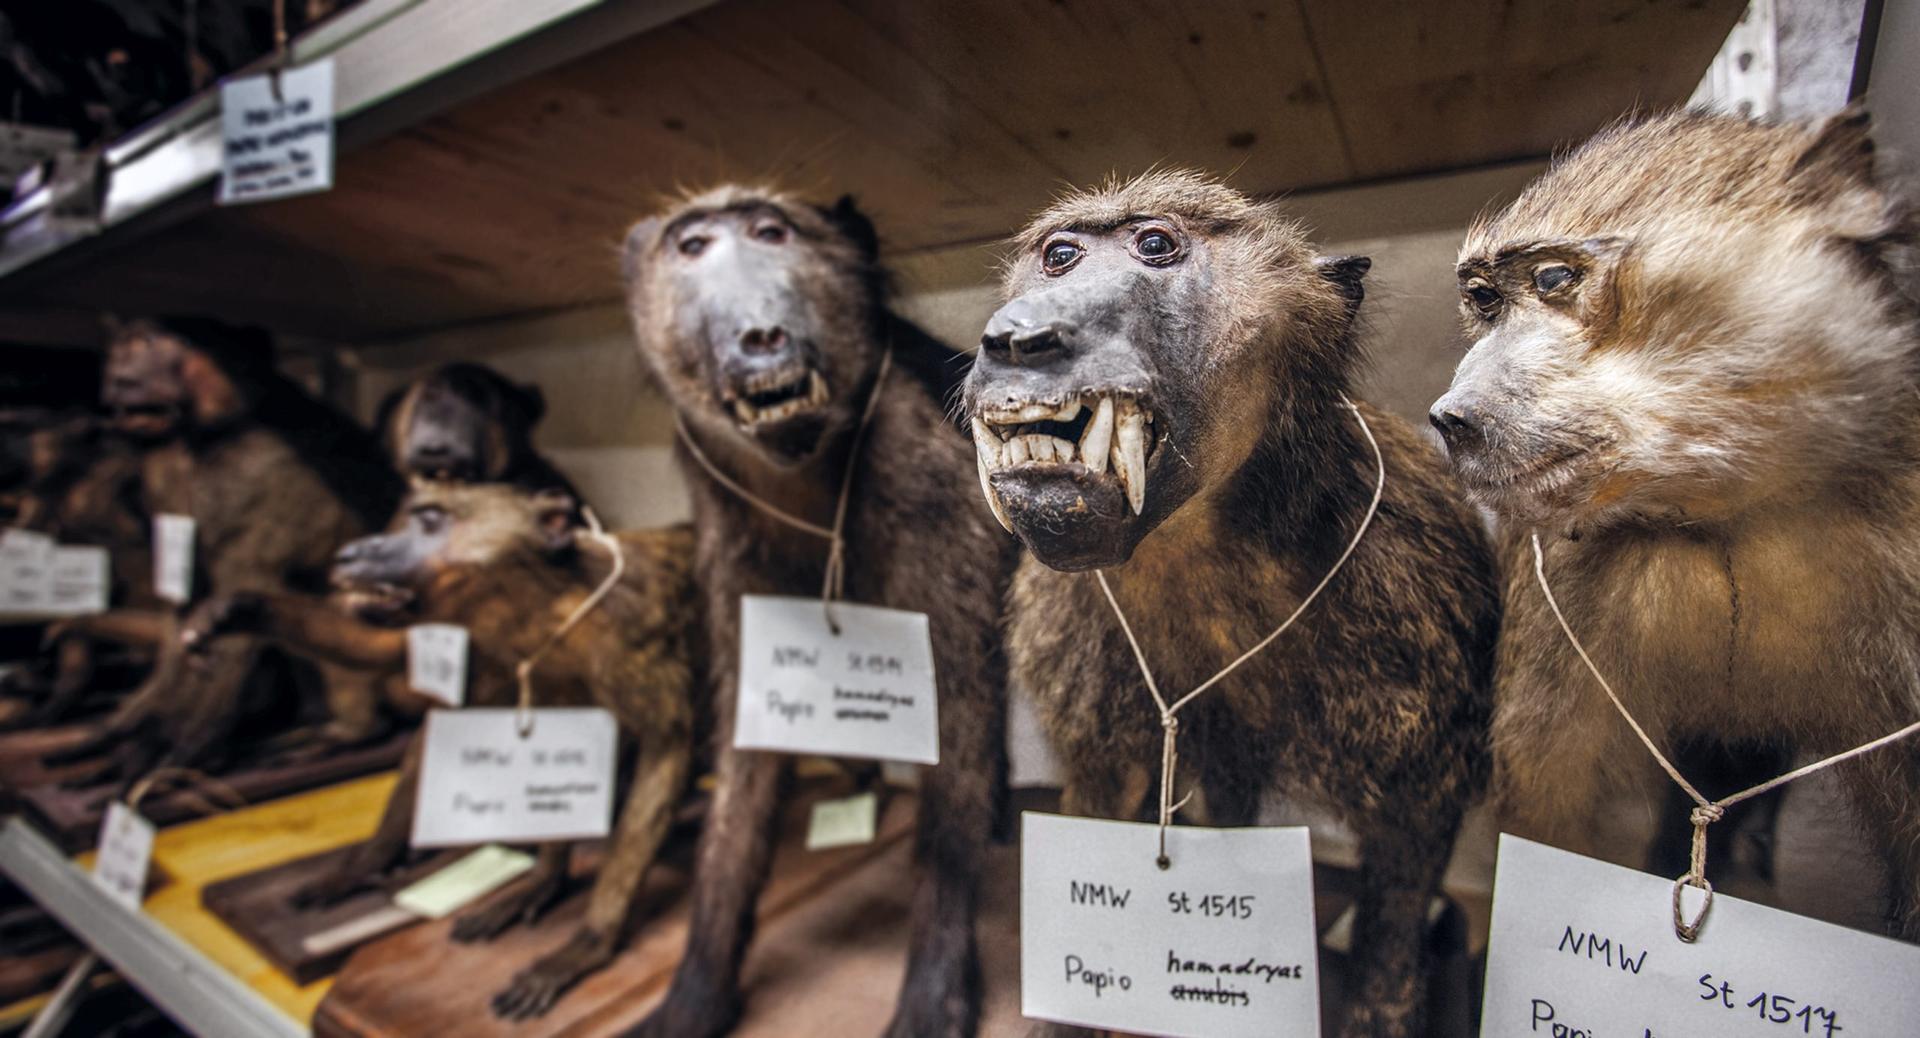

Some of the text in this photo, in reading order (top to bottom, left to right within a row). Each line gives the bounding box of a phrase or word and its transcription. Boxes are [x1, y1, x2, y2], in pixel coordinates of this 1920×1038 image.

[1070, 880, 1256, 921] NMW St 1515
[1064, 949, 1303, 998] Papio hamadryas
[1170, 977, 1251, 1007] anubis
[1557, 925, 1843, 1038] NMW St 1517
